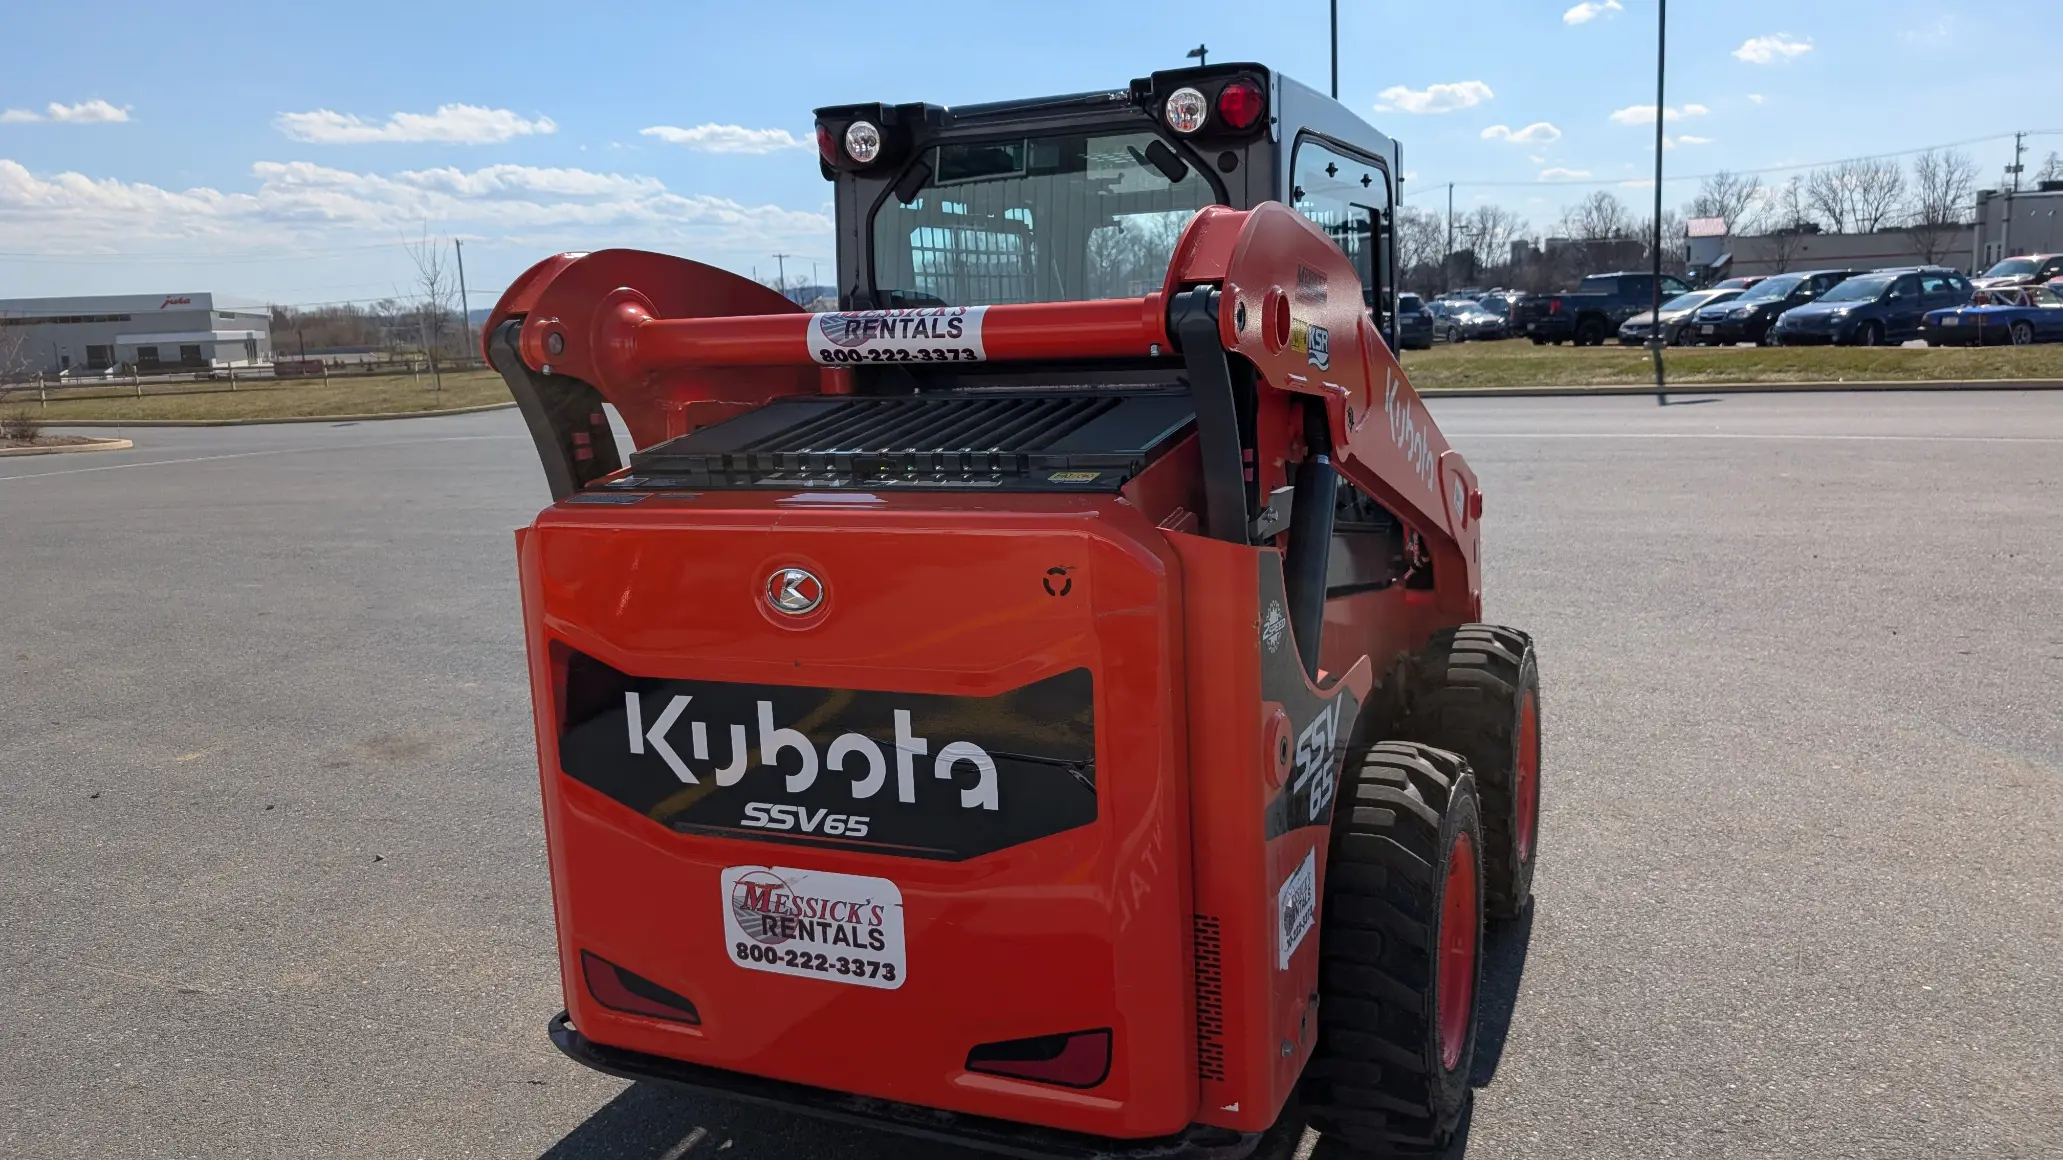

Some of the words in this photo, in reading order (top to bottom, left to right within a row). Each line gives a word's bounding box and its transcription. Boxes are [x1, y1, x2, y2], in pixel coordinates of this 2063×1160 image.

[844, 317, 964, 340] RENTALS
[1309, 326, 1328, 352] KSR
[819, 348, 978, 363] 800-222-3373
[1385, 366, 1434, 492] Kubota
[625, 691, 999, 811] Kubota
[1294, 692, 1342, 795] SSV
[1309, 755, 1334, 821] 65
[740, 802, 870, 837] SSV65
[735, 881, 885, 927] MESSICK'S
[761, 914, 886, 951] RENTALS
[735, 942, 896, 982] 800-222-3373
